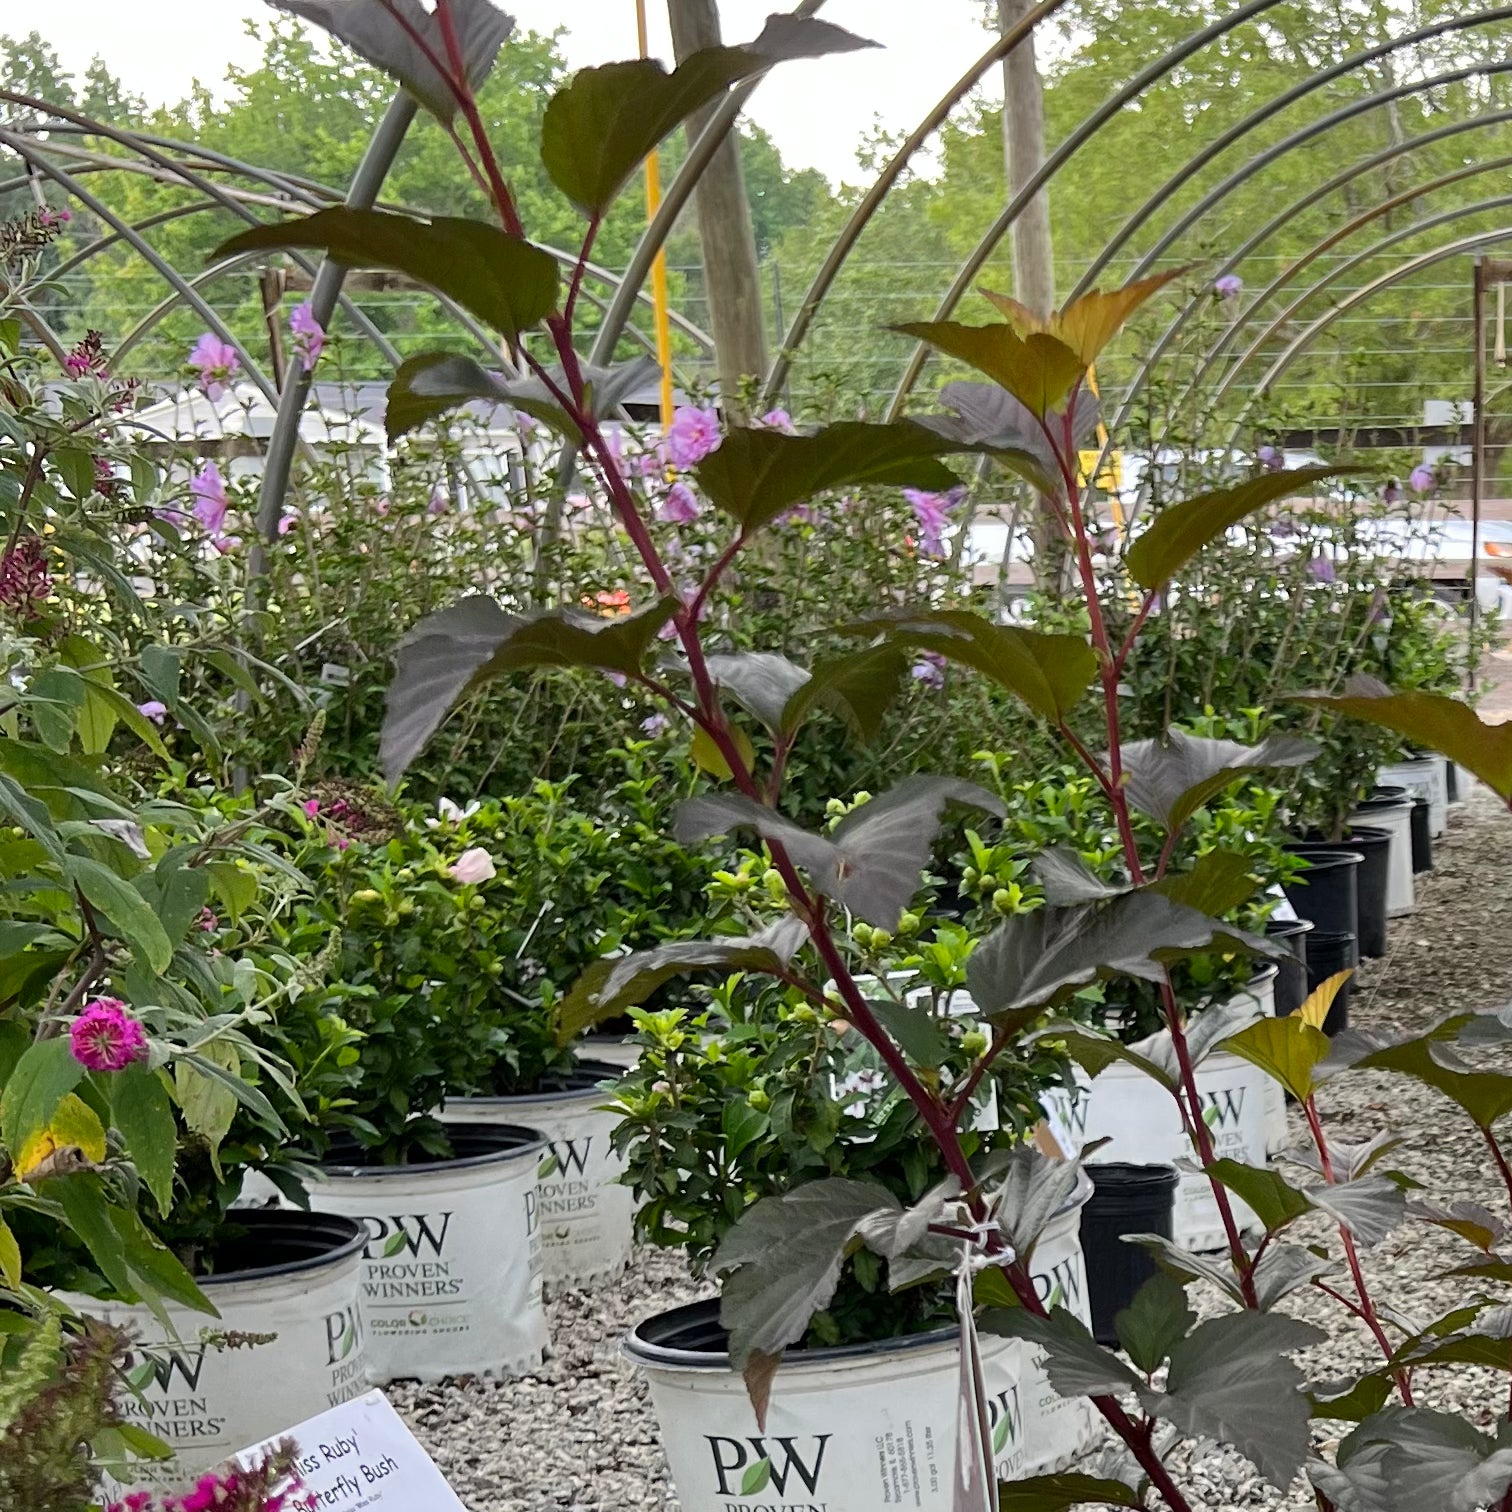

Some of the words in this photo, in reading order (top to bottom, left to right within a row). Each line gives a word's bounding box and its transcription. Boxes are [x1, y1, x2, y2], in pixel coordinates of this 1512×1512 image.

[363, 1212, 455, 1259] PW
[368, 1262, 450, 1280] PROVEN
[360, 1454, 399, 1483] Bush
[703, 1433, 834, 1498] PW
